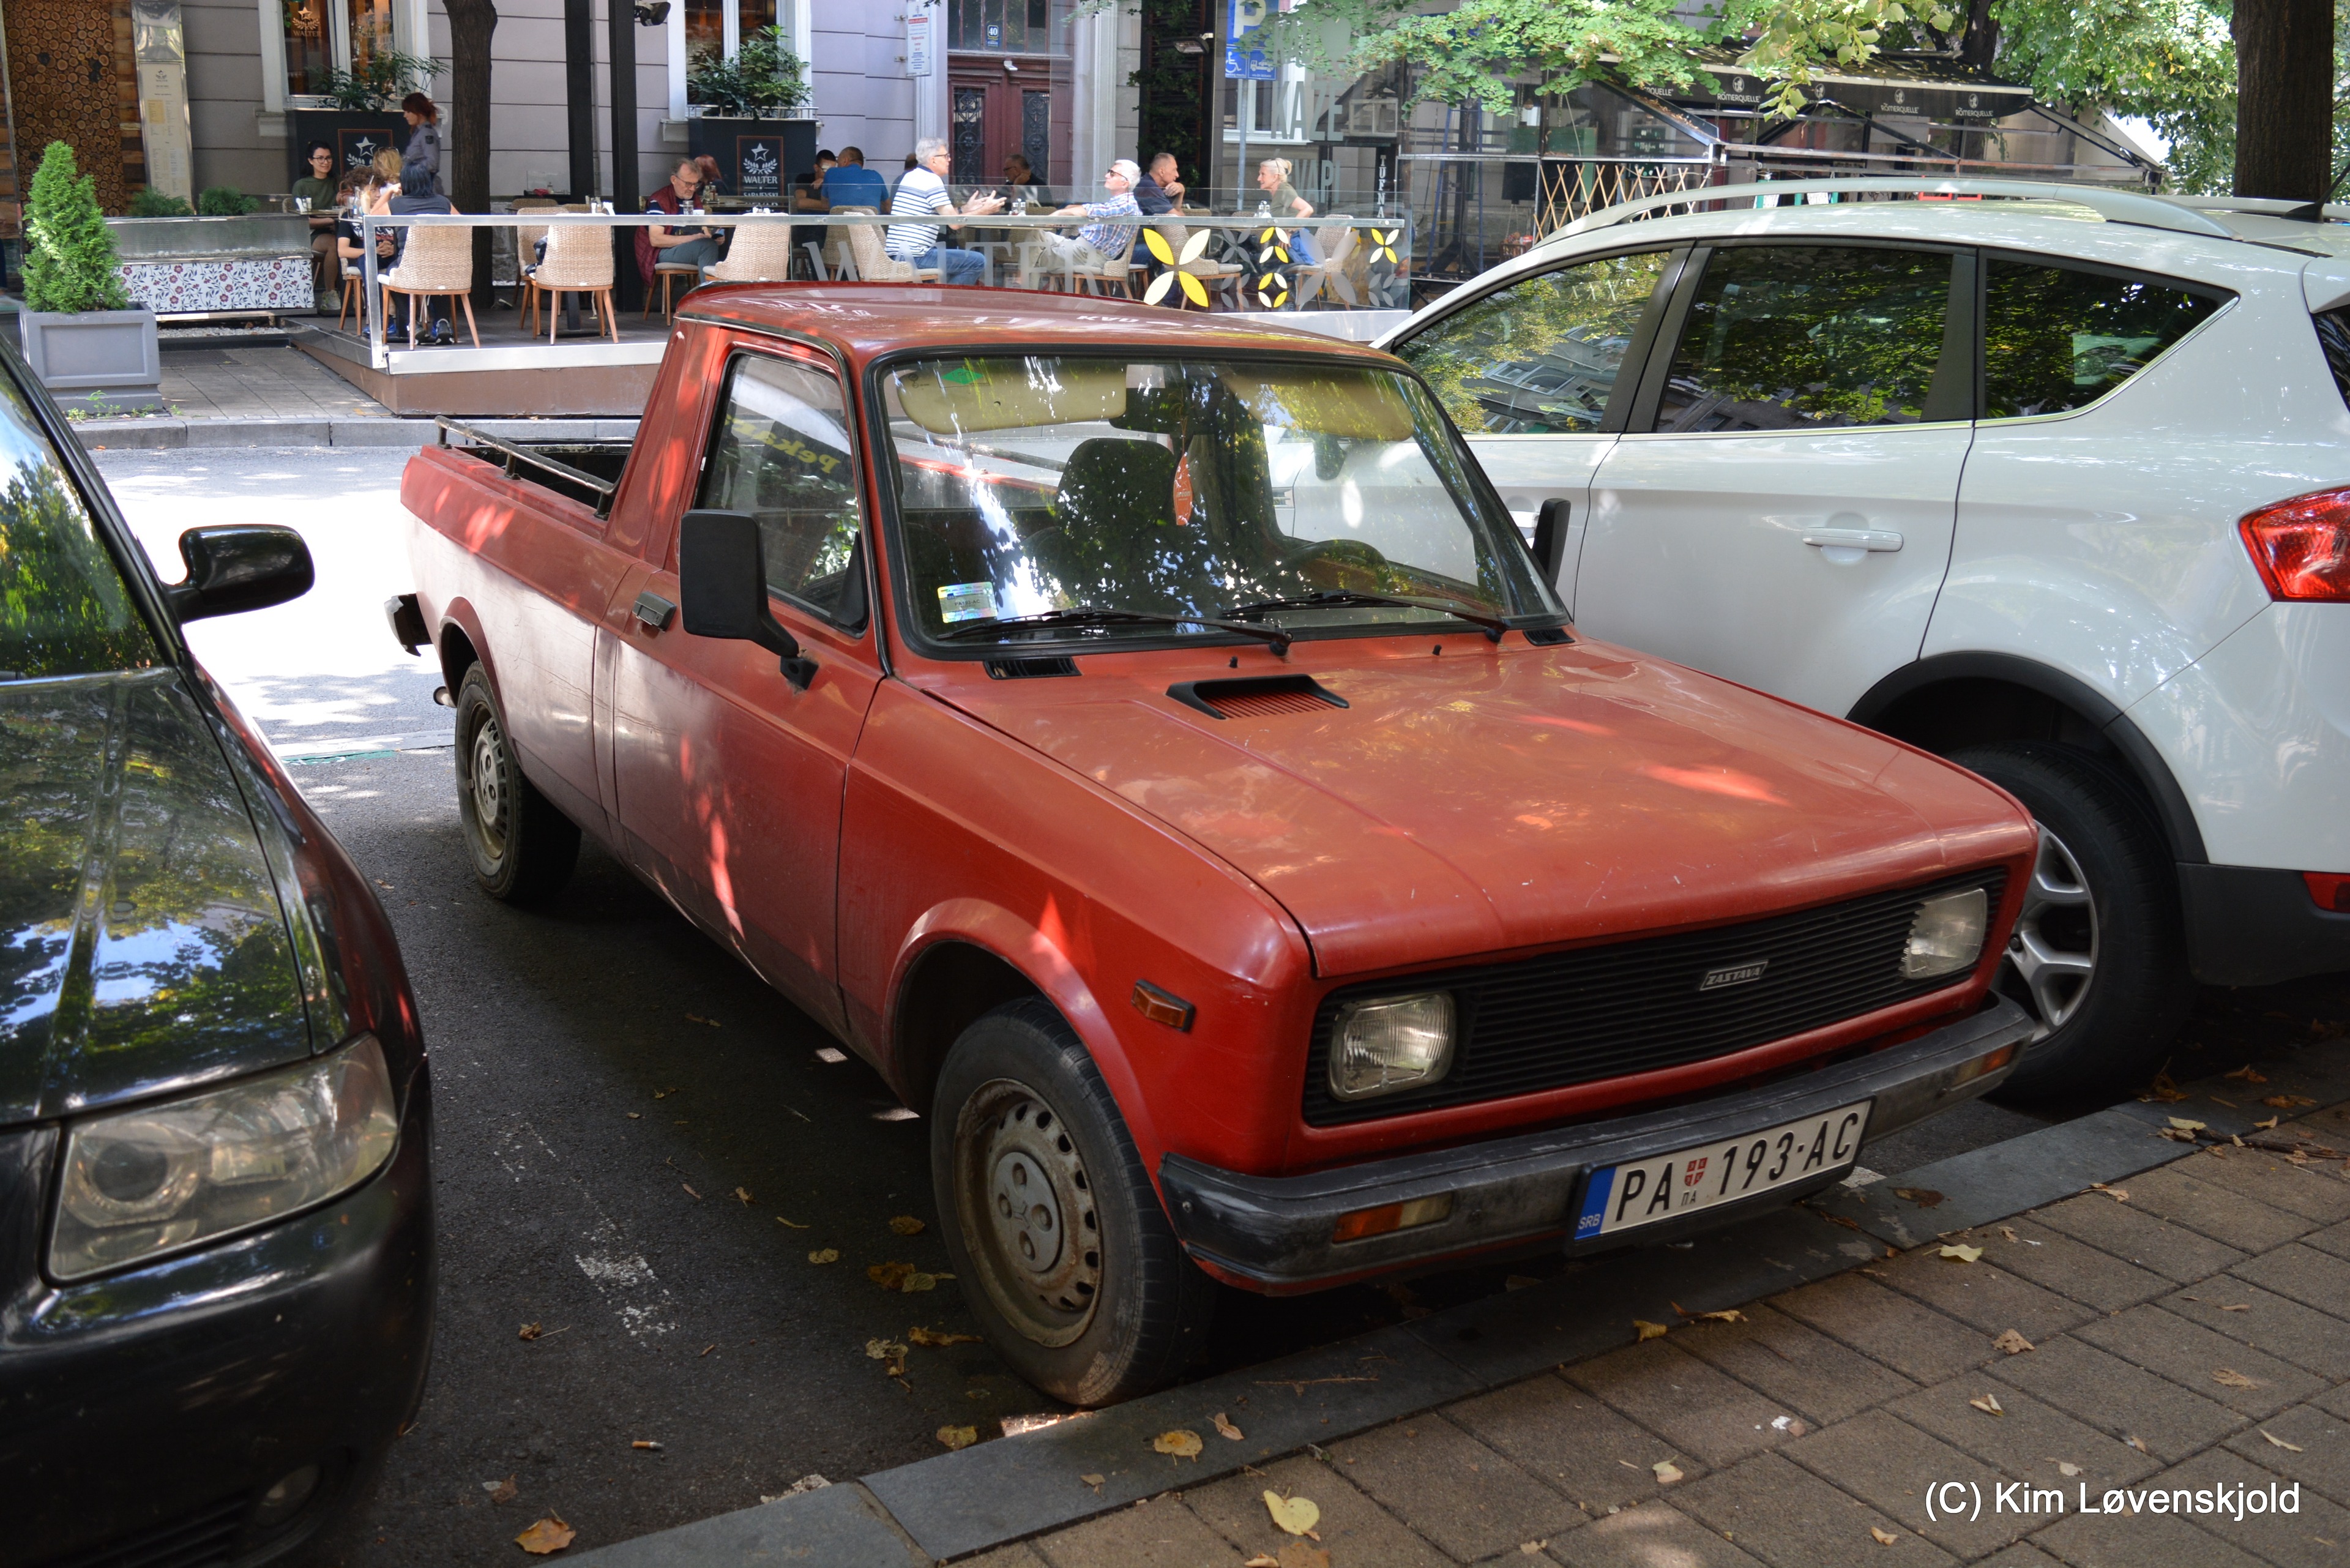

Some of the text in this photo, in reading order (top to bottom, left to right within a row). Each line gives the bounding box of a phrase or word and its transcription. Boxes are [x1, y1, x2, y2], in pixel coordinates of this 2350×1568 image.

[989, 27, 998, 35] 40
[1233, 0, 1266, 38] P
[1377, 155, 1387, 218] TUFNA
[802, 241, 1101, 297] WALTER
[1706, 967, 1761, 985] ZASTAVA
[1615, 1162, 1674, 1222] PA
[1578, 1214, 1601, 1230] SRB
